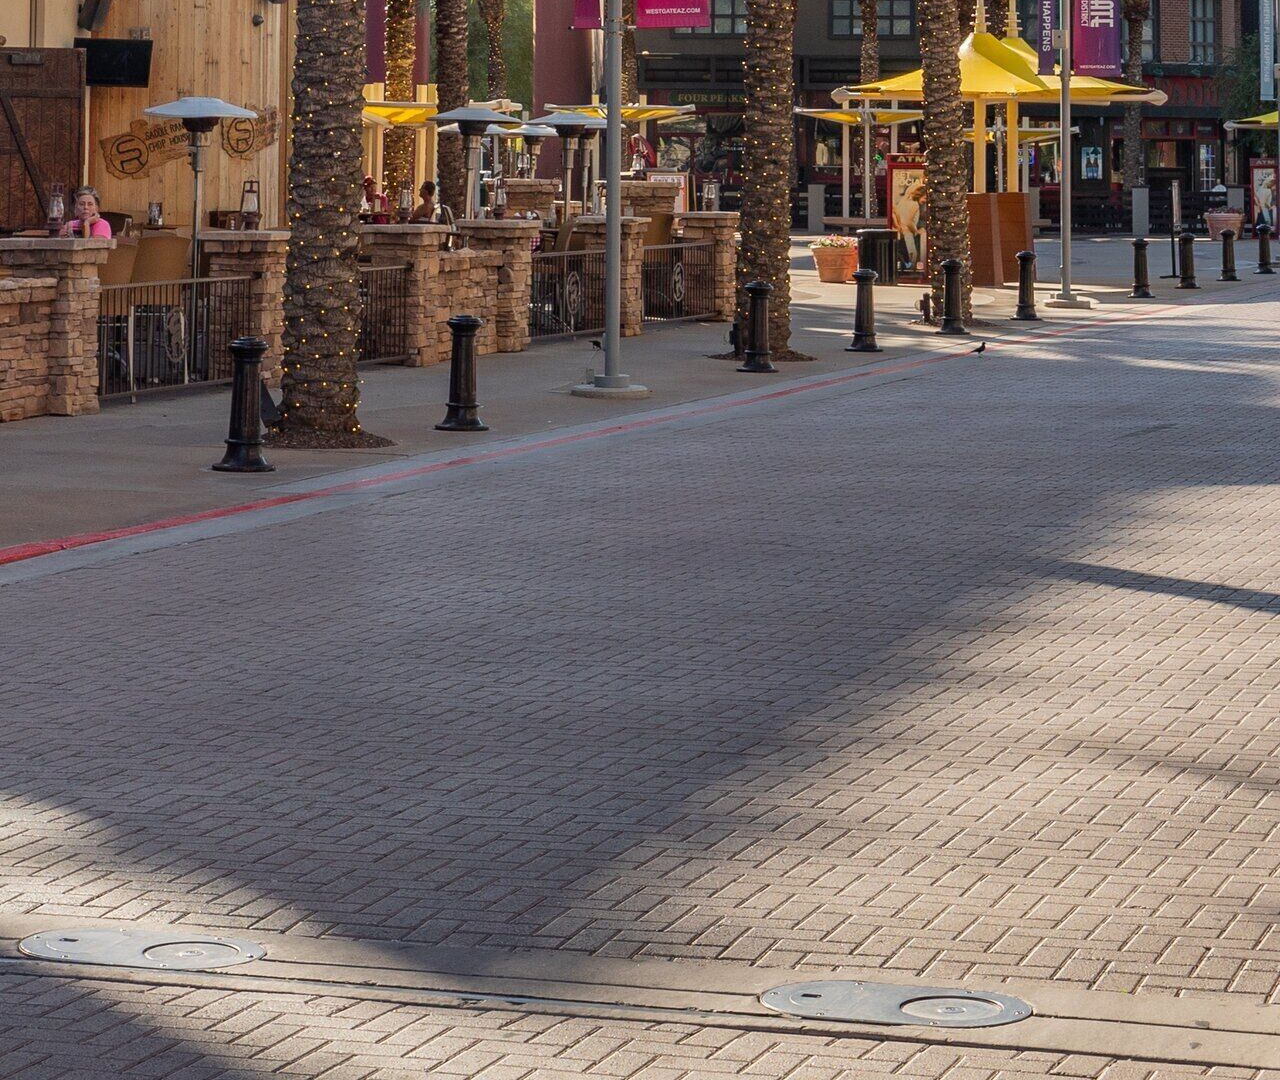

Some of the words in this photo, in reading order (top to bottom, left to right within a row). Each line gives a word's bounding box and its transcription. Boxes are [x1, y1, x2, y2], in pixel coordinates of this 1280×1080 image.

[645, 7, 701, 15] WESTGATEAZ.COM
[1080, 0, 1089, 27] DISTRICT
[1042, 1, 1051, 52] HAPPENS
[678, 94, 707, 102] FOUR
[145, 125, 169, 140] SADDLE
[149, 140, 166, 152] CHOP
